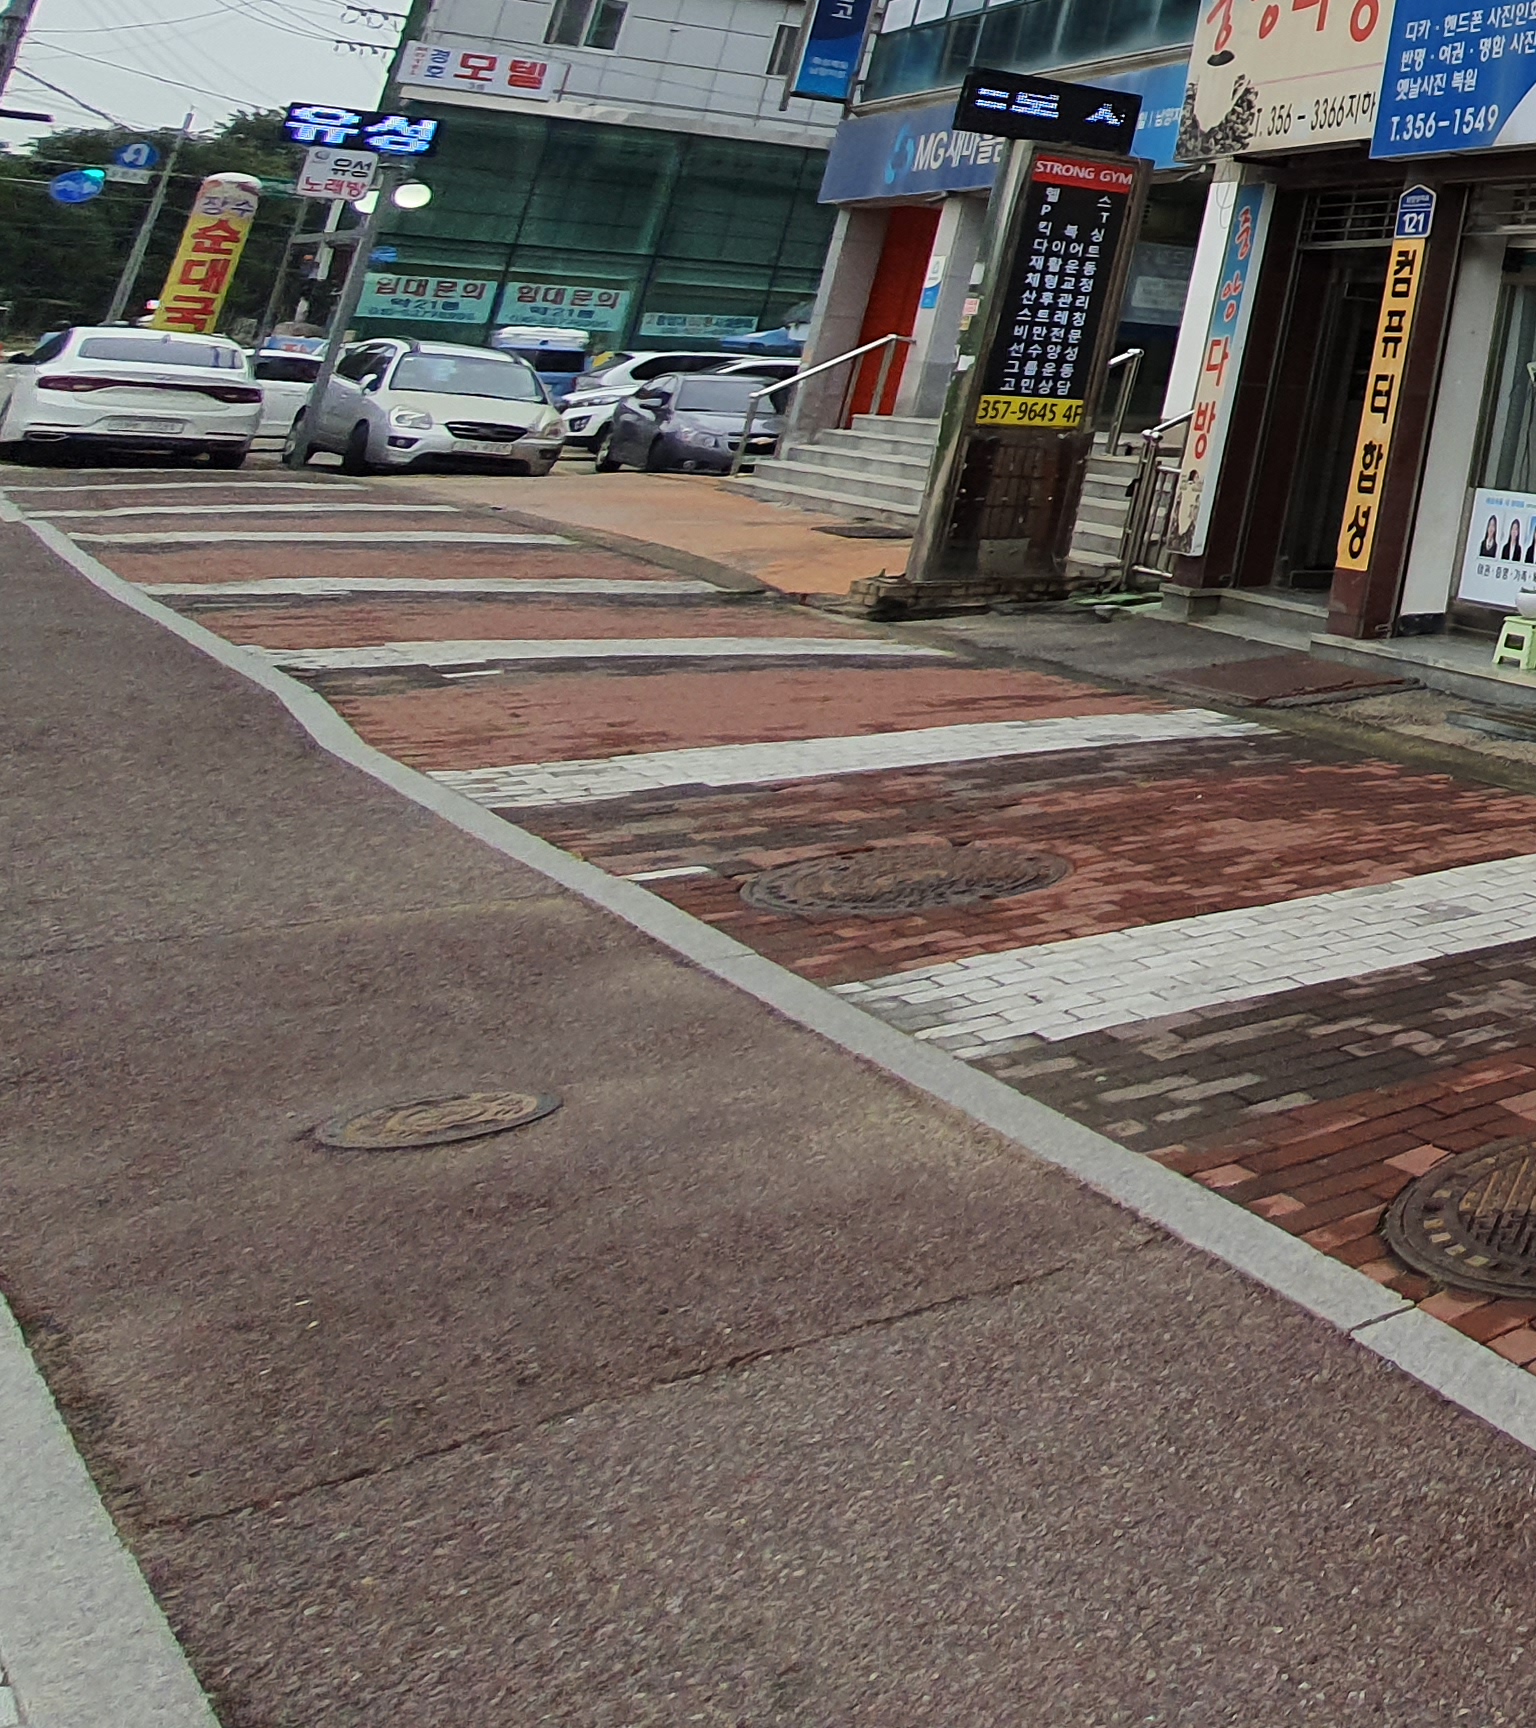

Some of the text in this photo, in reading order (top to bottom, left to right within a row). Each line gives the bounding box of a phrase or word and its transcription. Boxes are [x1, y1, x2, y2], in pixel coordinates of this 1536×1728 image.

[1406, 16, 1431, 42] 디카
[1443, 9, 1483, 34] 핸드폰
[453, 52, 548, 89] 모텔
[1390, 104, 1499, 142] T.356-1549
[1035, 159, 1133, 186] STRONG GYM
[1402, 211, 1425, 234] 121
[1032, 238, 1101, 259] 다이어트
[1028, 255, 1097, 276] 재활운동
[1021, 289, 1090, 310] 산후관리
[1016, 307, 1086, 328] 스트레칭
[1000, 377, 1071, 398] 고민상담
[978, 399, 1083, 425] 357-9645 4F
